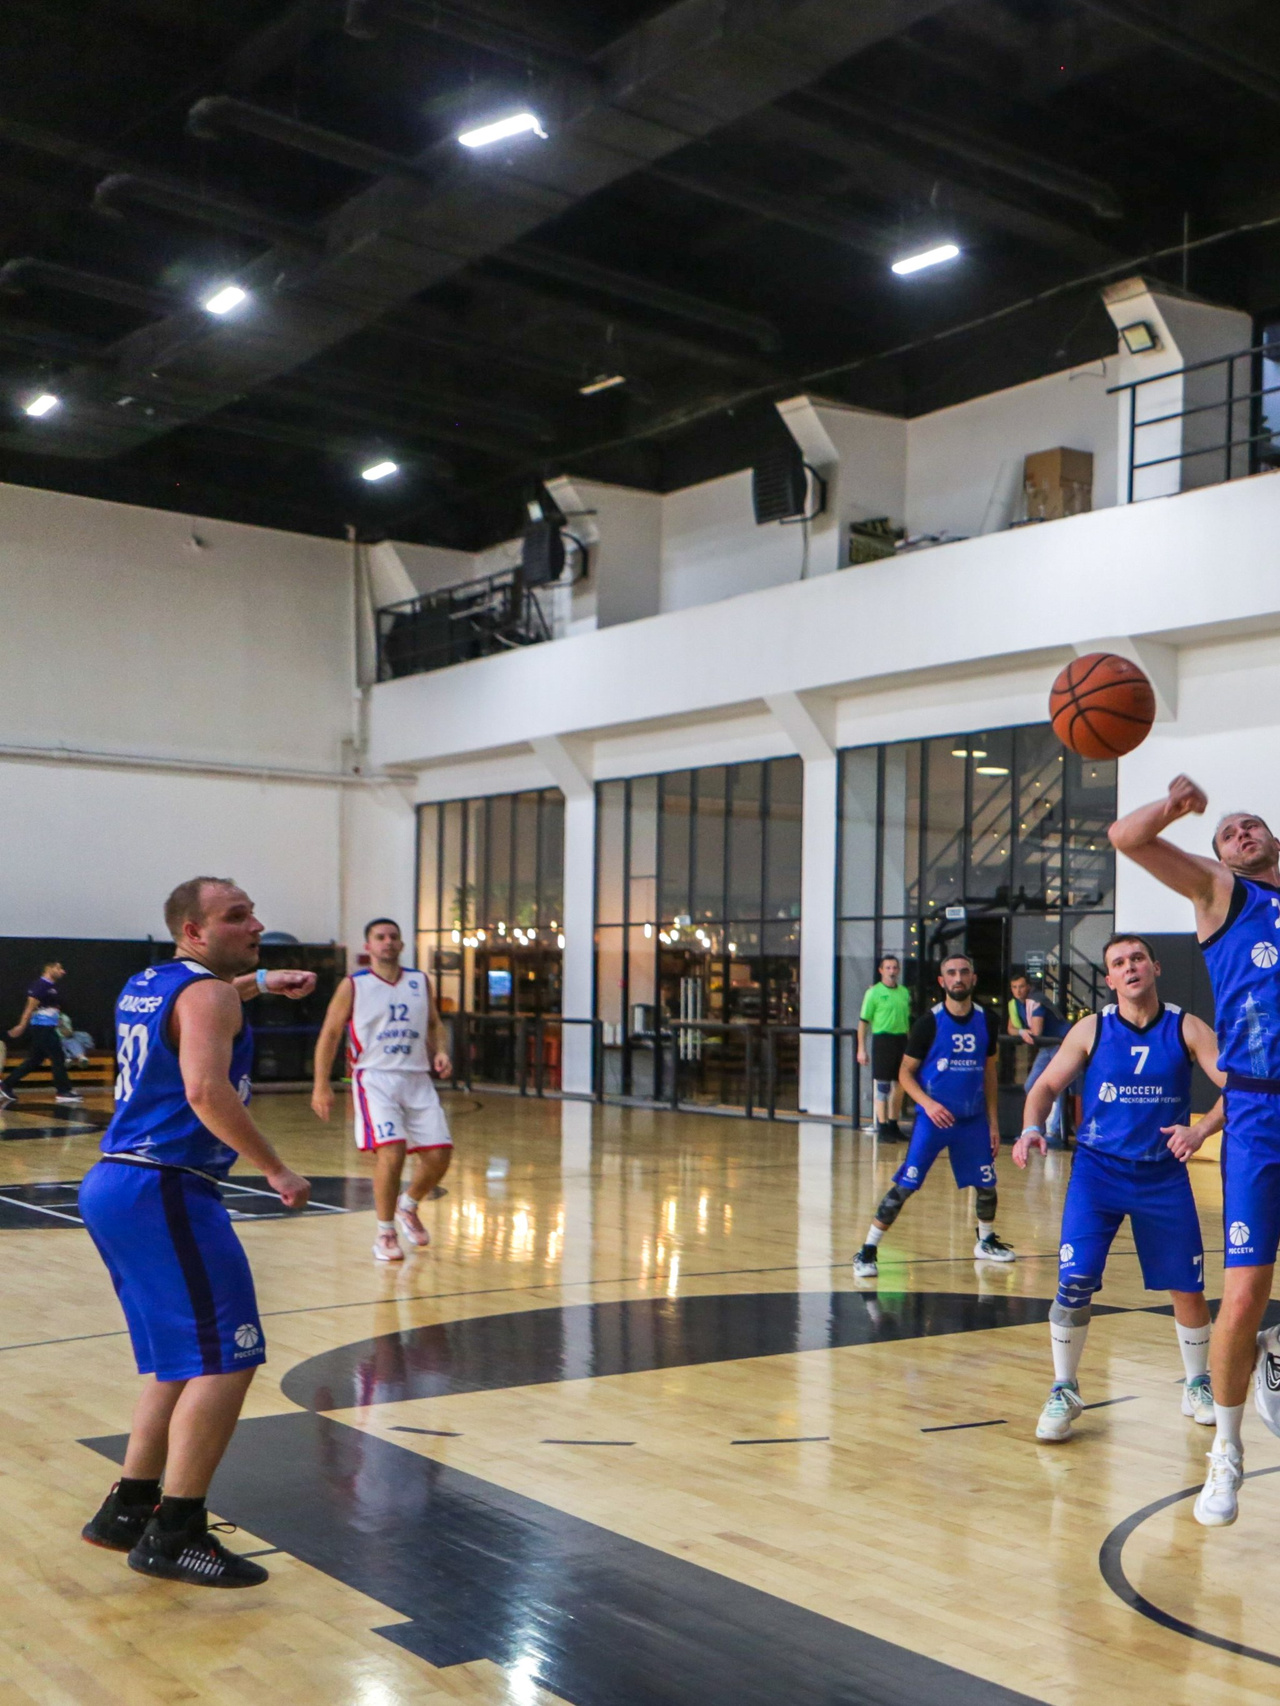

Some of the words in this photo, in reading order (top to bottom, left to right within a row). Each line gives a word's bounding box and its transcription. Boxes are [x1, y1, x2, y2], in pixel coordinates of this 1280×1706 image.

[389, 1003, 410, 1022] 12
[951, 1033, 976, 1053] 33
[1130, 1045, 1150, 1075] 7
[1119, 1085, 1163, 1095] РОССЕТИ
[377, 1121, 397, 1138] 12
